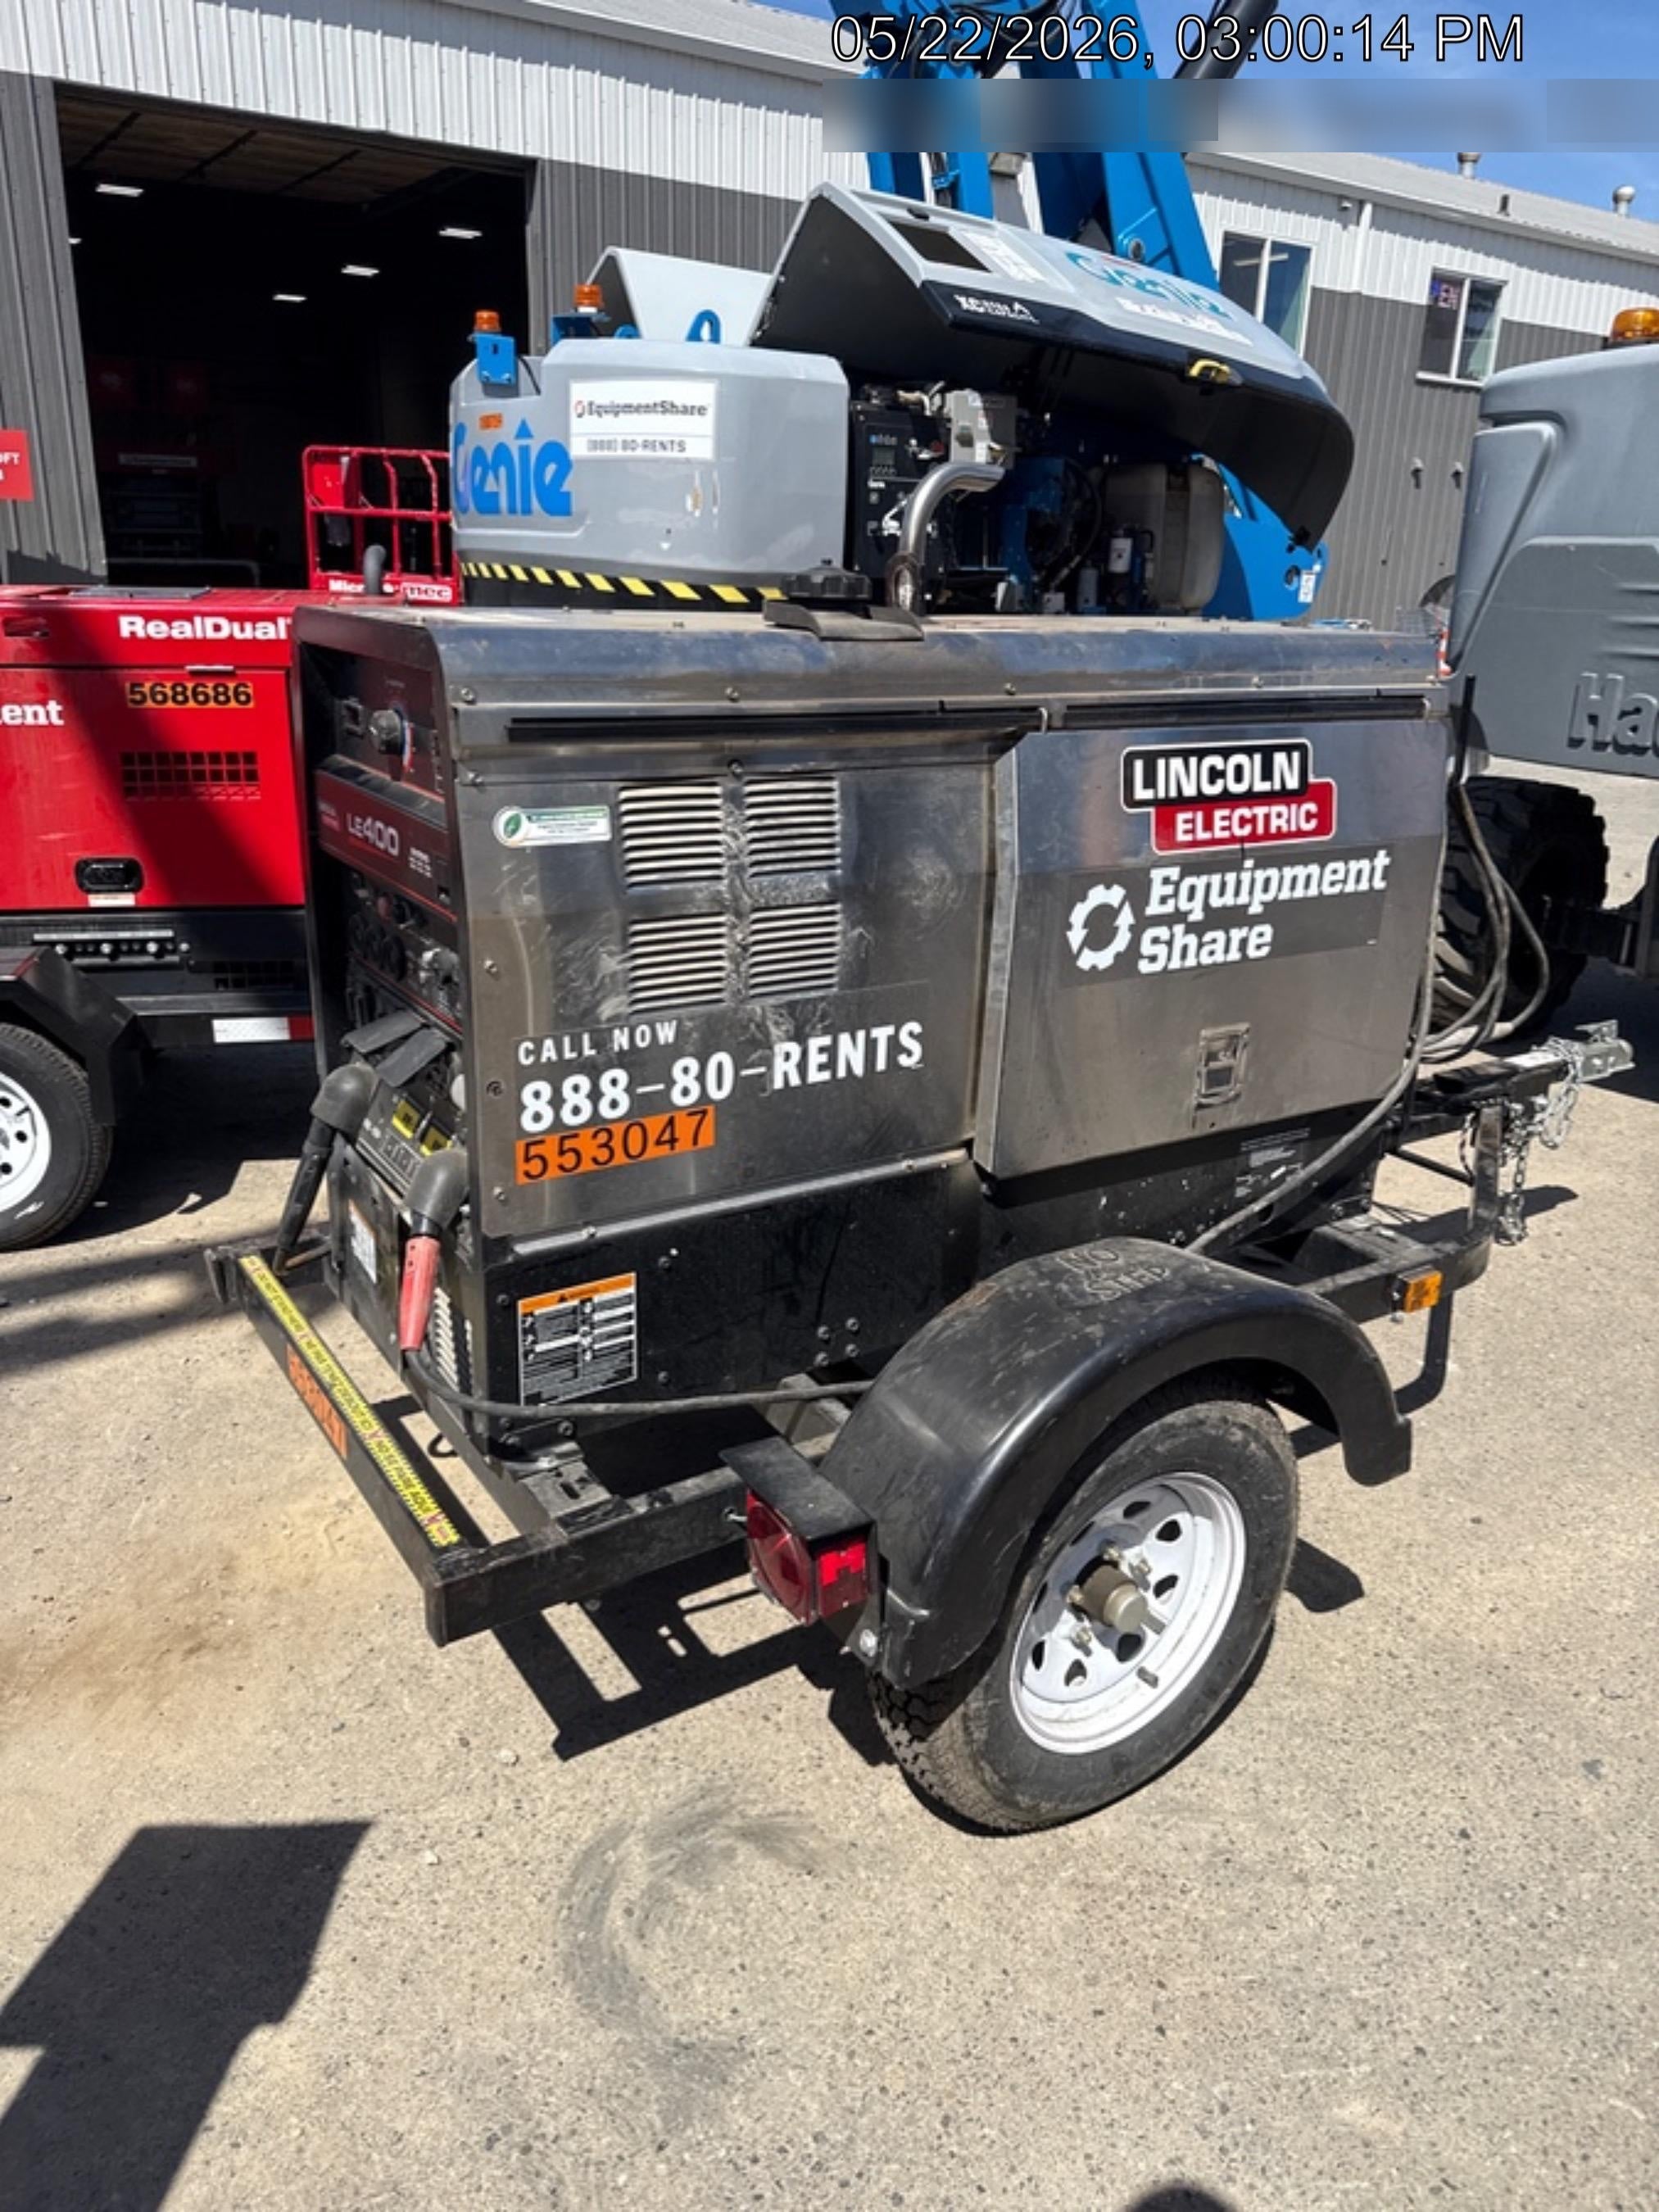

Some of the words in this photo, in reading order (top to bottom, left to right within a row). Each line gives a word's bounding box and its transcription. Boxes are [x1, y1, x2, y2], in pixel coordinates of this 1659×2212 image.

[587, 400, 708, 418] EquipmentShare
[118, 615, 289, 640] RealDual
[0, 699, 65, 727] ent
[128, 682, 252, 706] 568686
[1566, 671, 1659, 759] Ha
[1133, 750, 1301, 800] LINCOLN
[1175, 802, 1318, 843] ELECTRIC
[1145, 849, 1392, 922] Equipment
[1137, 922, 1274, 974] Share
[518, 1031, 596, 1066] CALL
[613, 1019, 678, 1051] NOW
[519, 1021, 923, 1133] 888-80-RENTS
[522, 1108, 710, 1181] 553047
[1056, 1249, 1122, 1273] NO
